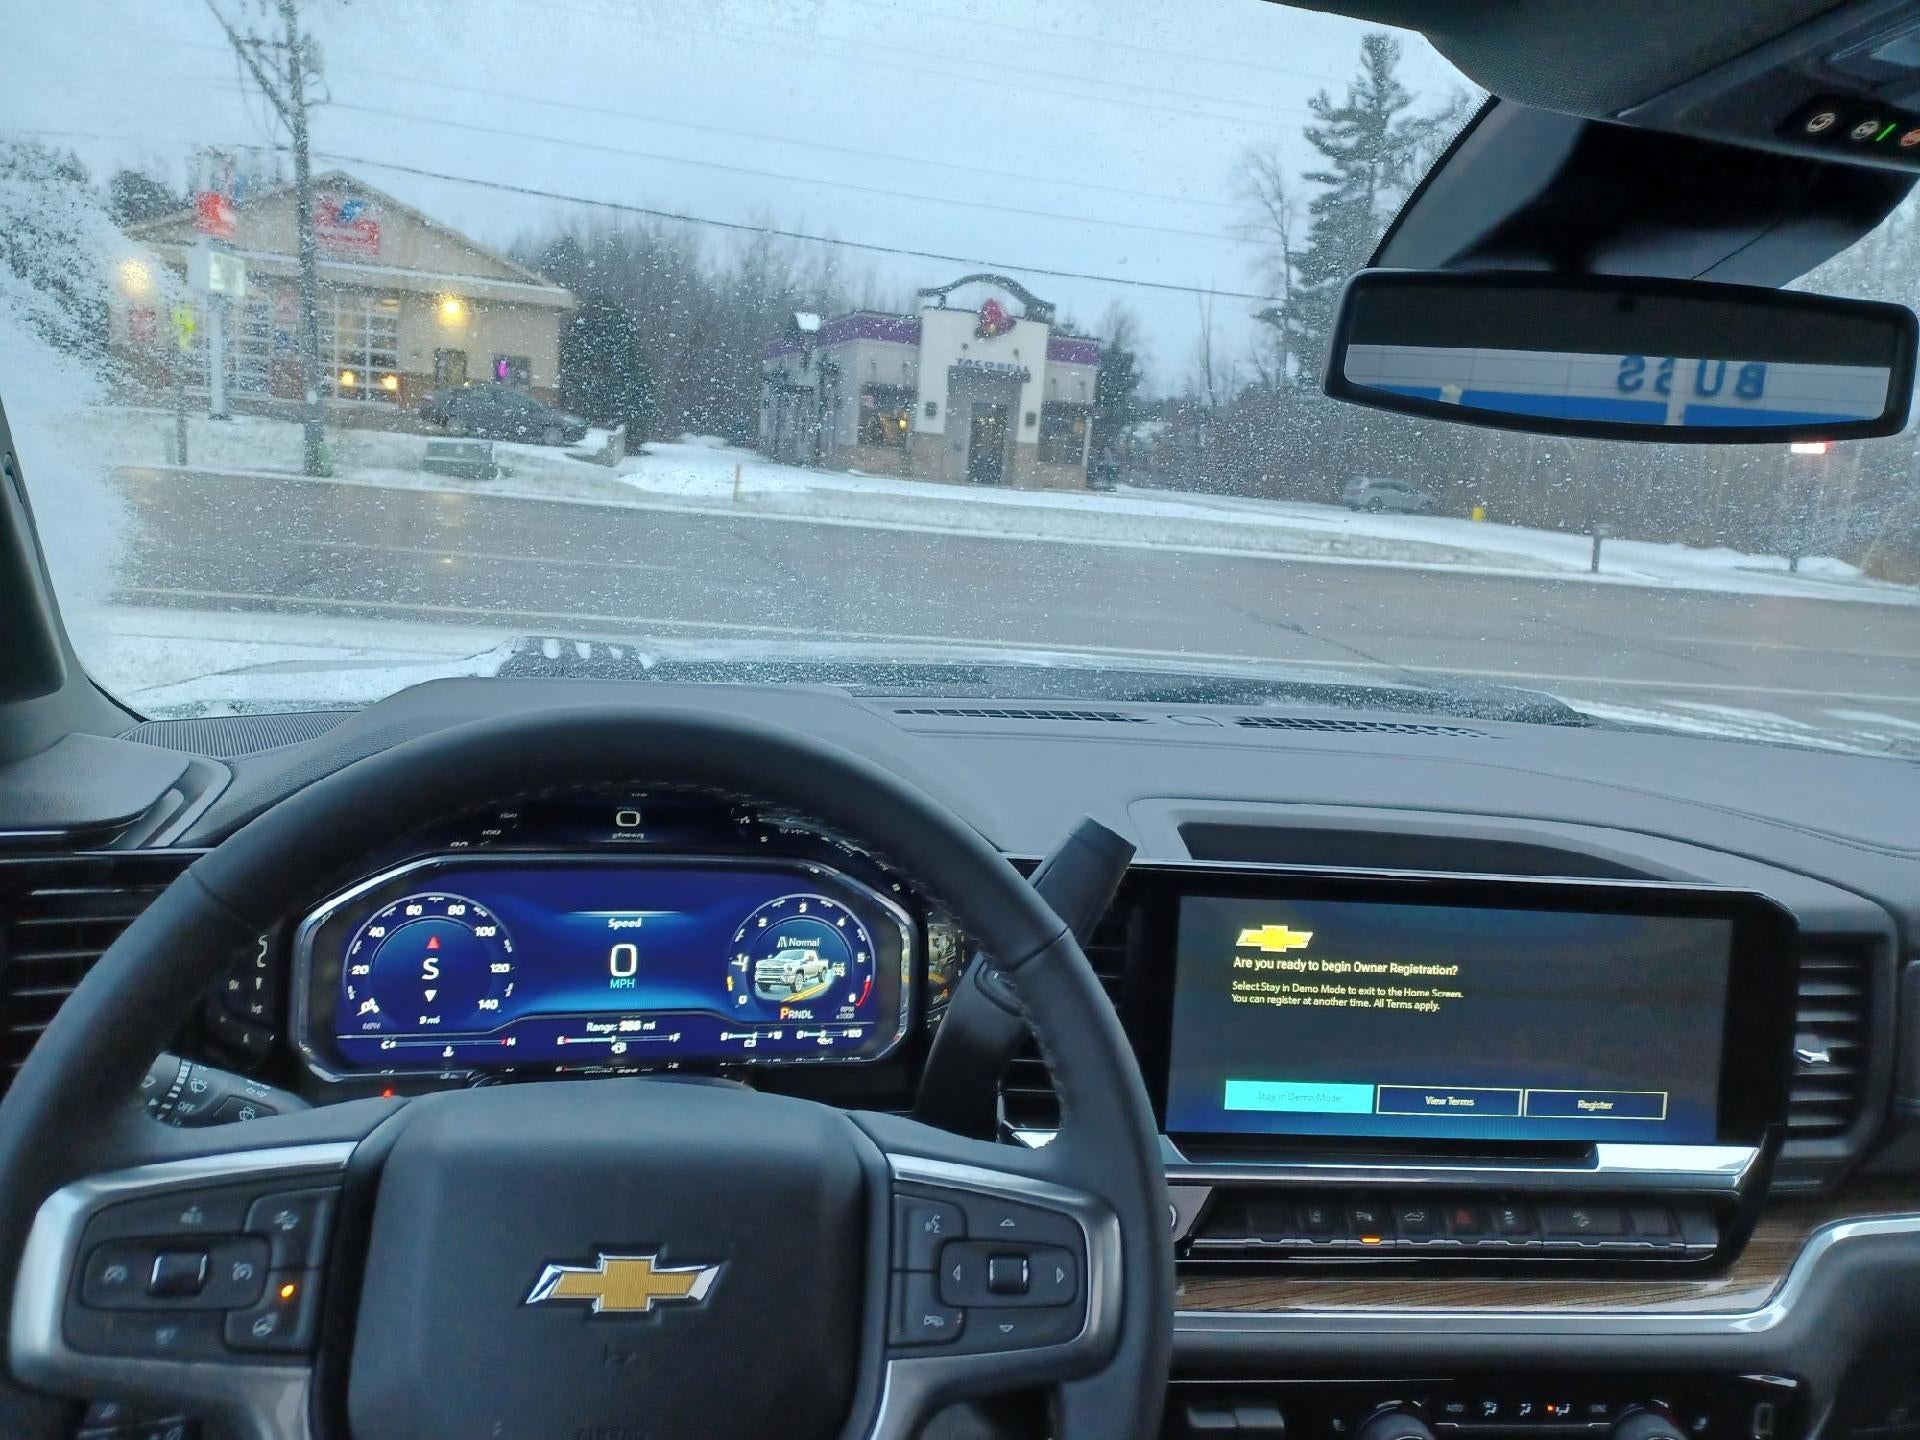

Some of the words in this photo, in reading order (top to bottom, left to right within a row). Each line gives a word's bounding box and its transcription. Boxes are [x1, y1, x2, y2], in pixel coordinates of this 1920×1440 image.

[956, 358, 994, 370] TACO
[406, 905, 423, 916] 60
[608, 917, 642, 930] Speed
[758, 918, 767, 928] 2
[368, 926, 385, 938] 40
[475, 926, 496, 937] 100
[788, 937, 820, 948] Normal
[610, 943, 638, 977] 0
[857, 952, 866, 963] 5
[351, 964, 370, 975] 20
[421, 957, 440, 980] S
[490, 963, 510, 974] 120
[1233, 956, 1253, 969] Are
[1255, 960, 1276, 972] you
[1277, 959, 1307, 972] ready
[1308, 960, 1319, 971] to
[1321, 960, 1351, 974] begin
[1354, 961, 1388, 973] Owner
[1390, 962, 1458, 976] Registration?
[610, 978, 635, 989] MPH
[1232, 981, 1260, 992] Select
[1260, 982, 1281, 995] Stay
[1282, 982, 1290, 992] in
[1292, 983, 1319, 994] Demo
[1321, 984, 1346, 995] Mode
[1348, 985, 1357, 995] to
[1358, 985, 1375, 996] exit
[1377, 986, 1386, 996] to
[1388, 986, 1402, 997] the
[1403, 987, 1430, 998] Home
[1431, 988, 1464, 998] Screen.
[478, 999, 499, 1010] 140
[738, 995, 748, 1005] 0
[1231, 994, 1248, 1004] You
[1249, 996, 1265, 1004] can
[1267, 995, 1301, 1007] register
[1302, 997, 1312, 1005] at
[1313, 997, 1348, 1007] another
[1349, 998, 1371, 1008] time.
[1373, 999, 1384, 1008] All
[1386, 999, 1412, 1010] Terms
[1414, 1000, 1440, 1012] apply.
[1257, 1091, 1277, 1103] Stay
[1279, 1092, 1286, 1100] in
[1288, 1092, 1313, 1102] Demo
[1314, 1093, 1342, 1102] Mode
[1425, 1096, 1446, 1106] View
[1447, 1096, 1474, 1107] Terms
[178, 1101, 195, 1113] OFF
[1577, 1100, 1613, 1111] Register
